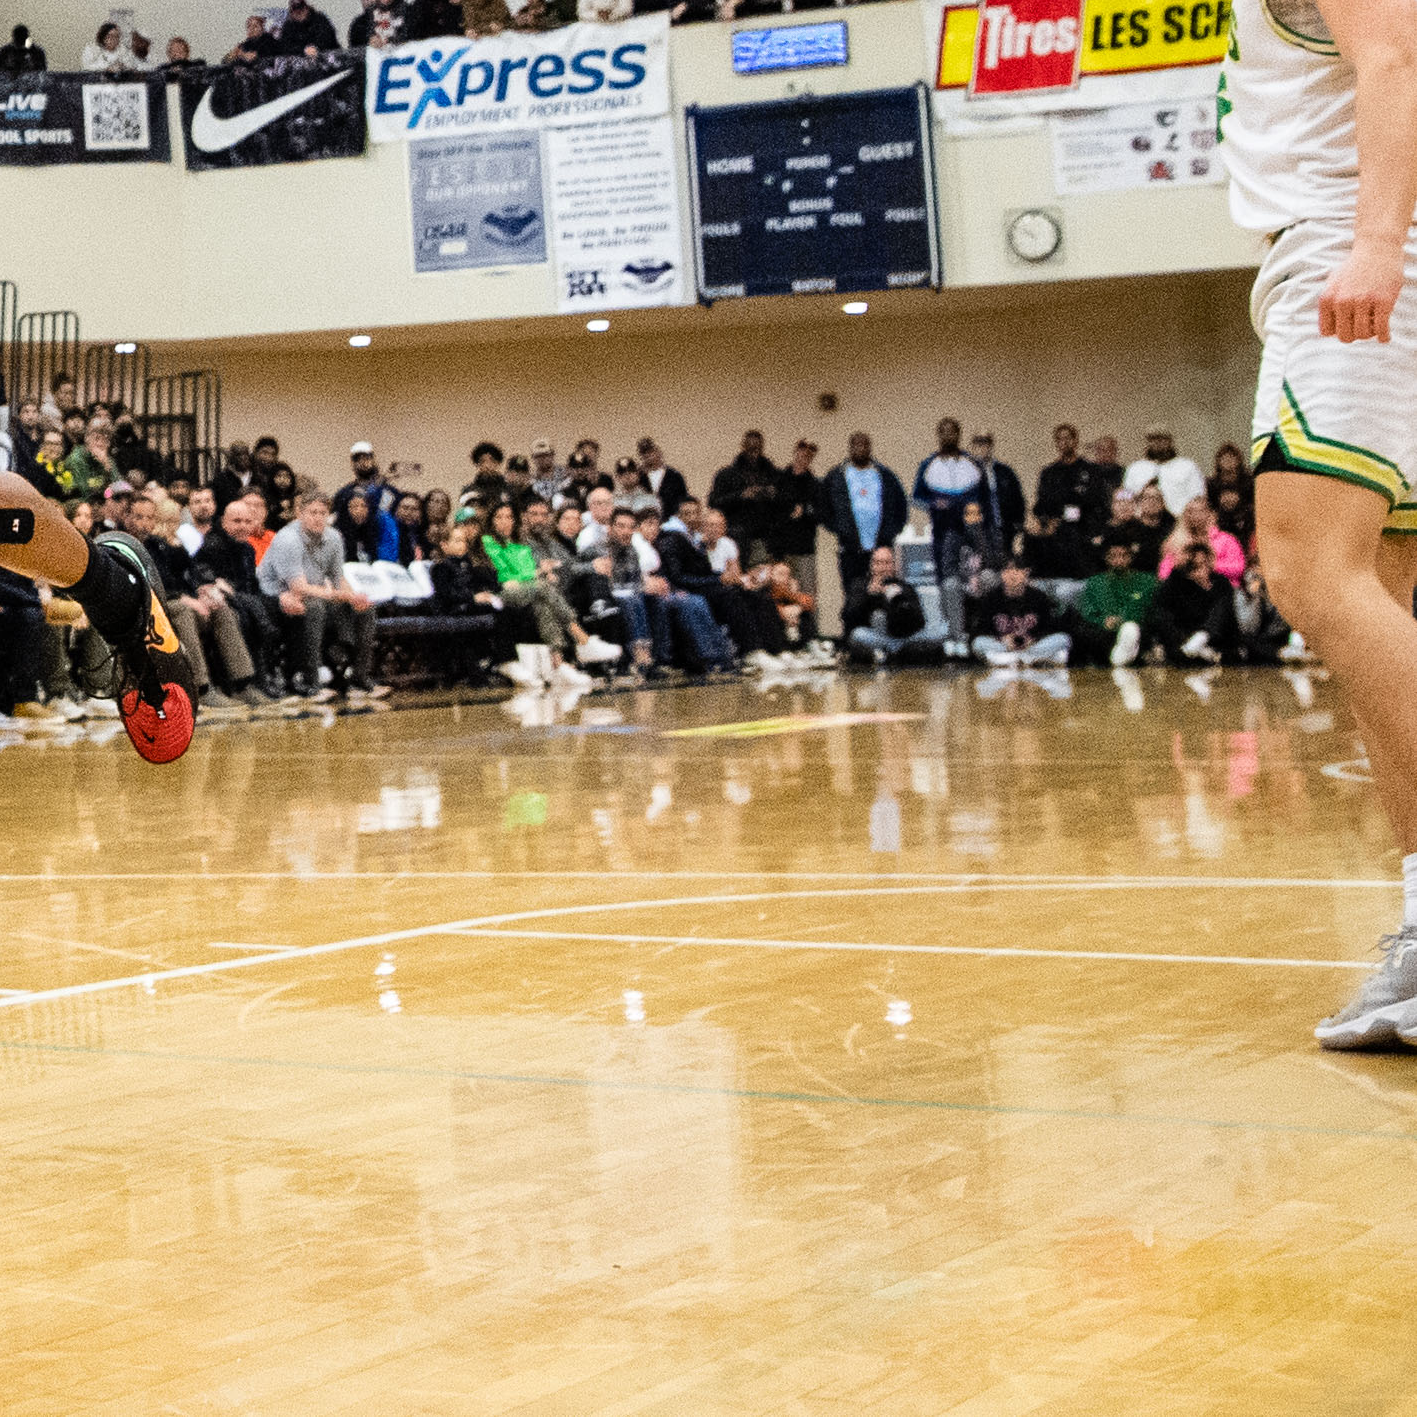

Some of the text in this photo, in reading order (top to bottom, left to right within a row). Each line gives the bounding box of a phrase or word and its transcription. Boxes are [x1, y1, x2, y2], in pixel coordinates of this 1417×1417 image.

[981, 0, 1232, 70] Tires LES SCH
[424, 106, 520, 130] EMPLOYMENT
[23, 128, 74, 145] SPORTS
[706, 155, 755, 175] HOME
[858, 141, 915, 163] GUEST
